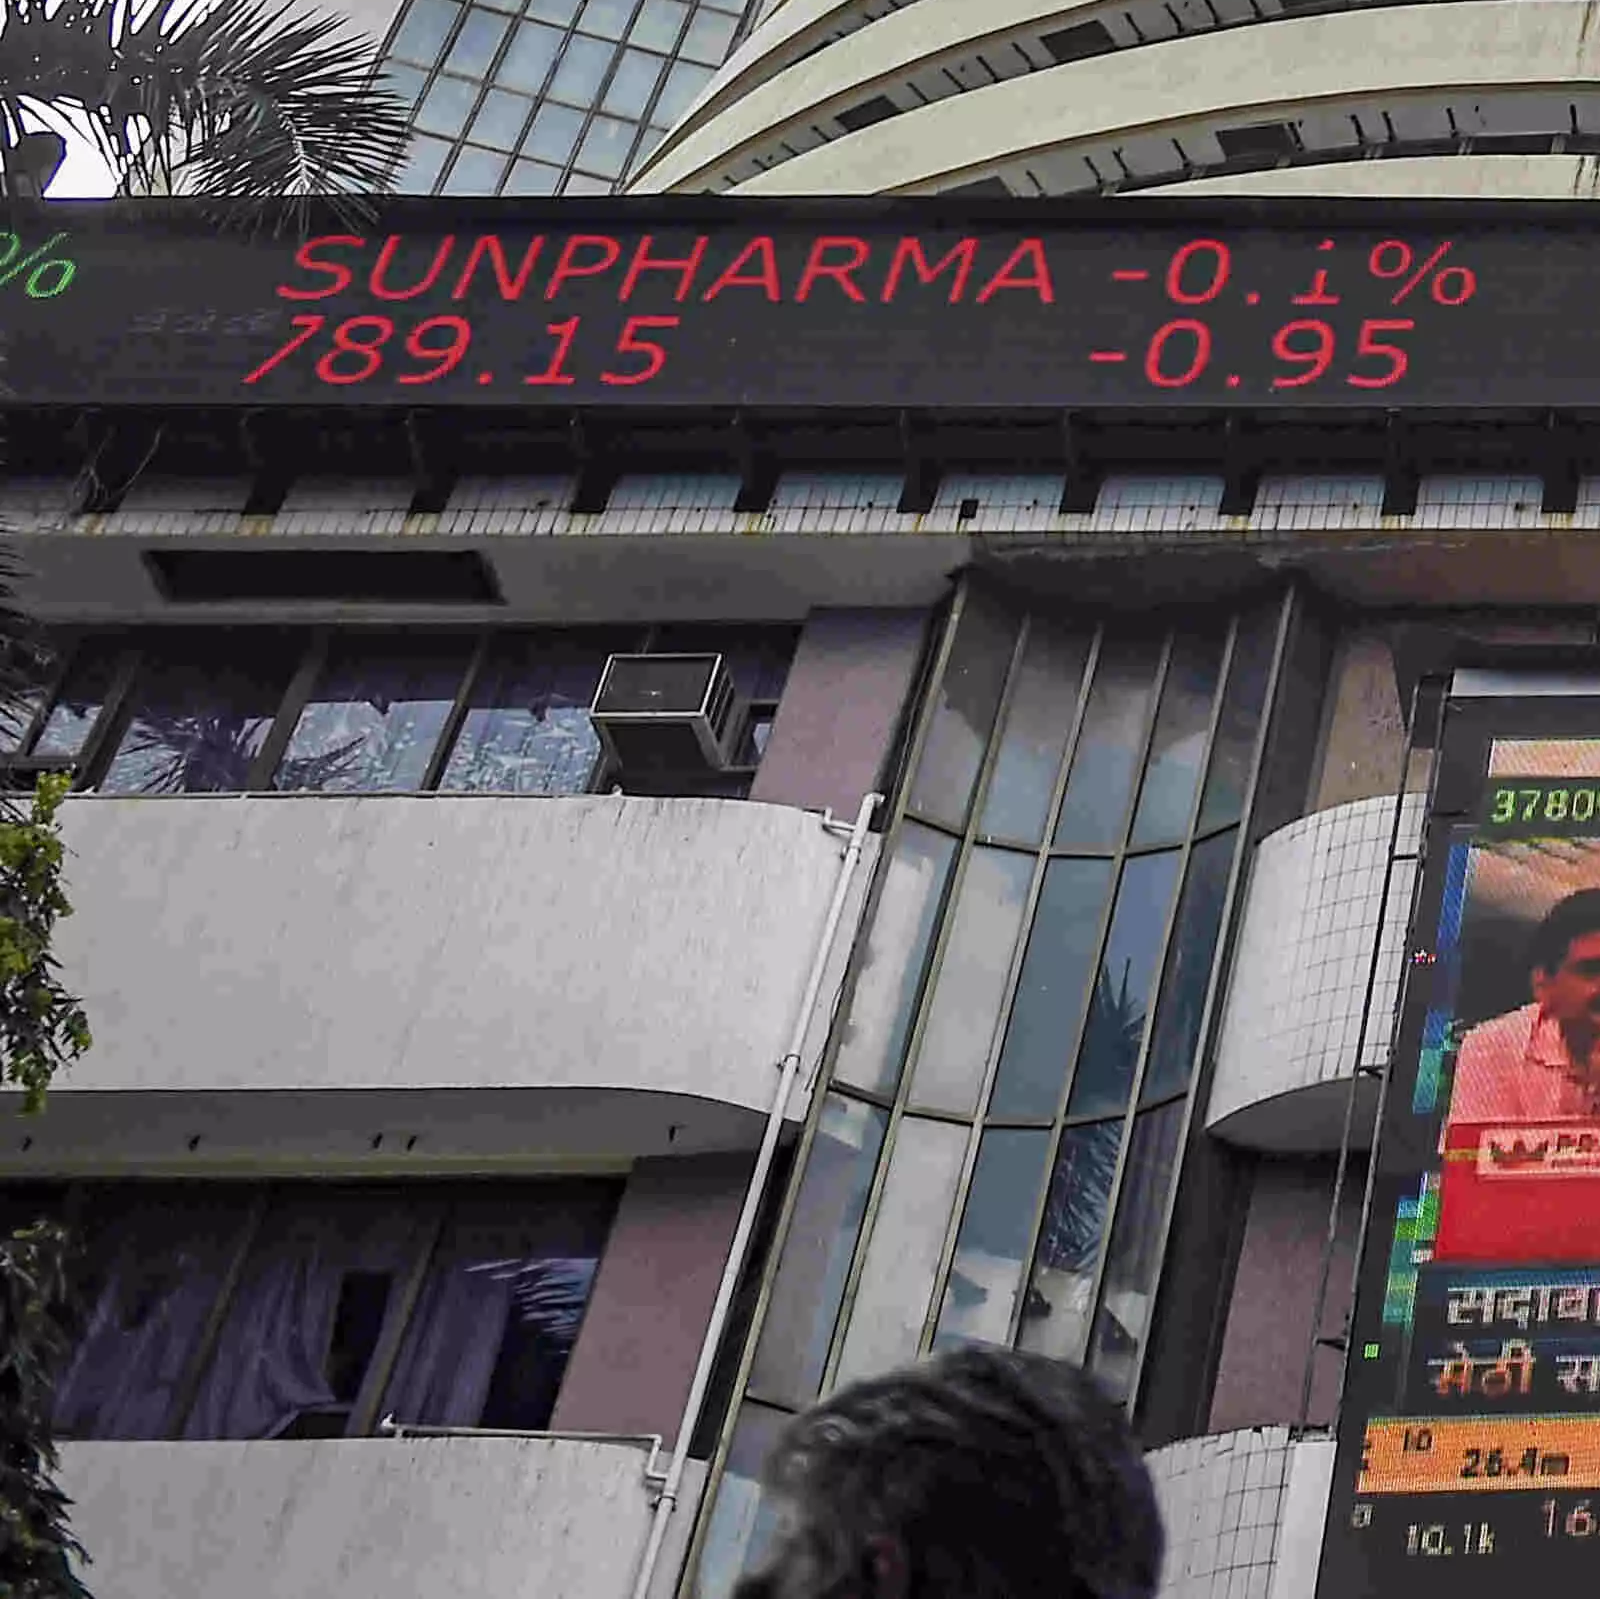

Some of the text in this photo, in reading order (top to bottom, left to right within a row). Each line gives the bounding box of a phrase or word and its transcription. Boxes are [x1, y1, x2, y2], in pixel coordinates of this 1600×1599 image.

[276, 233, 1056, 304] SUNPHARMA
[241, 314, 1415, 388] 789.15 -0.95
